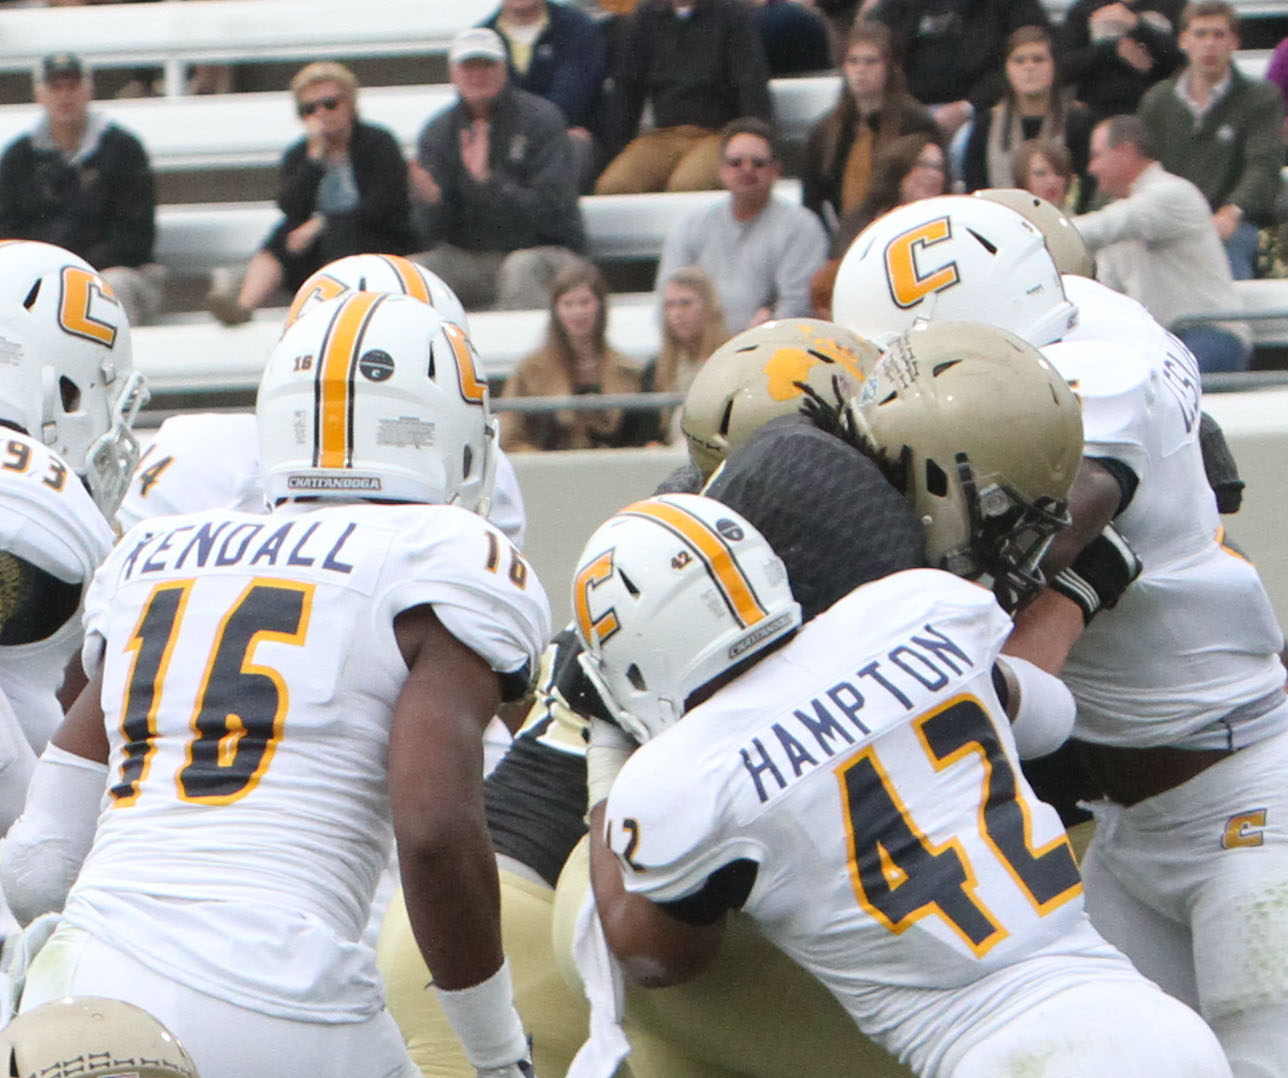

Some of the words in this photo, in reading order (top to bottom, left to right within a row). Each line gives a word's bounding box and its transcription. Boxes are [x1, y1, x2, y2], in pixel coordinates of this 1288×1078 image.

[883, 215, 961, 309] C
[293, 355, 313, 373] 16
[0, 439, 69, 494] 93
[288, 476, 382, 492] CHATTANOOGA
[122, 520, 357, 581] KENDALL
[483, 529, 530, 592] 16
[671, 550, 694, 571] 42
[108, 576, 317, 809] 16
[739, 623, 974, 804] HAMPTON
[832, 692, 1086, 960] 42
[1219, 808, 1267, 850] C
